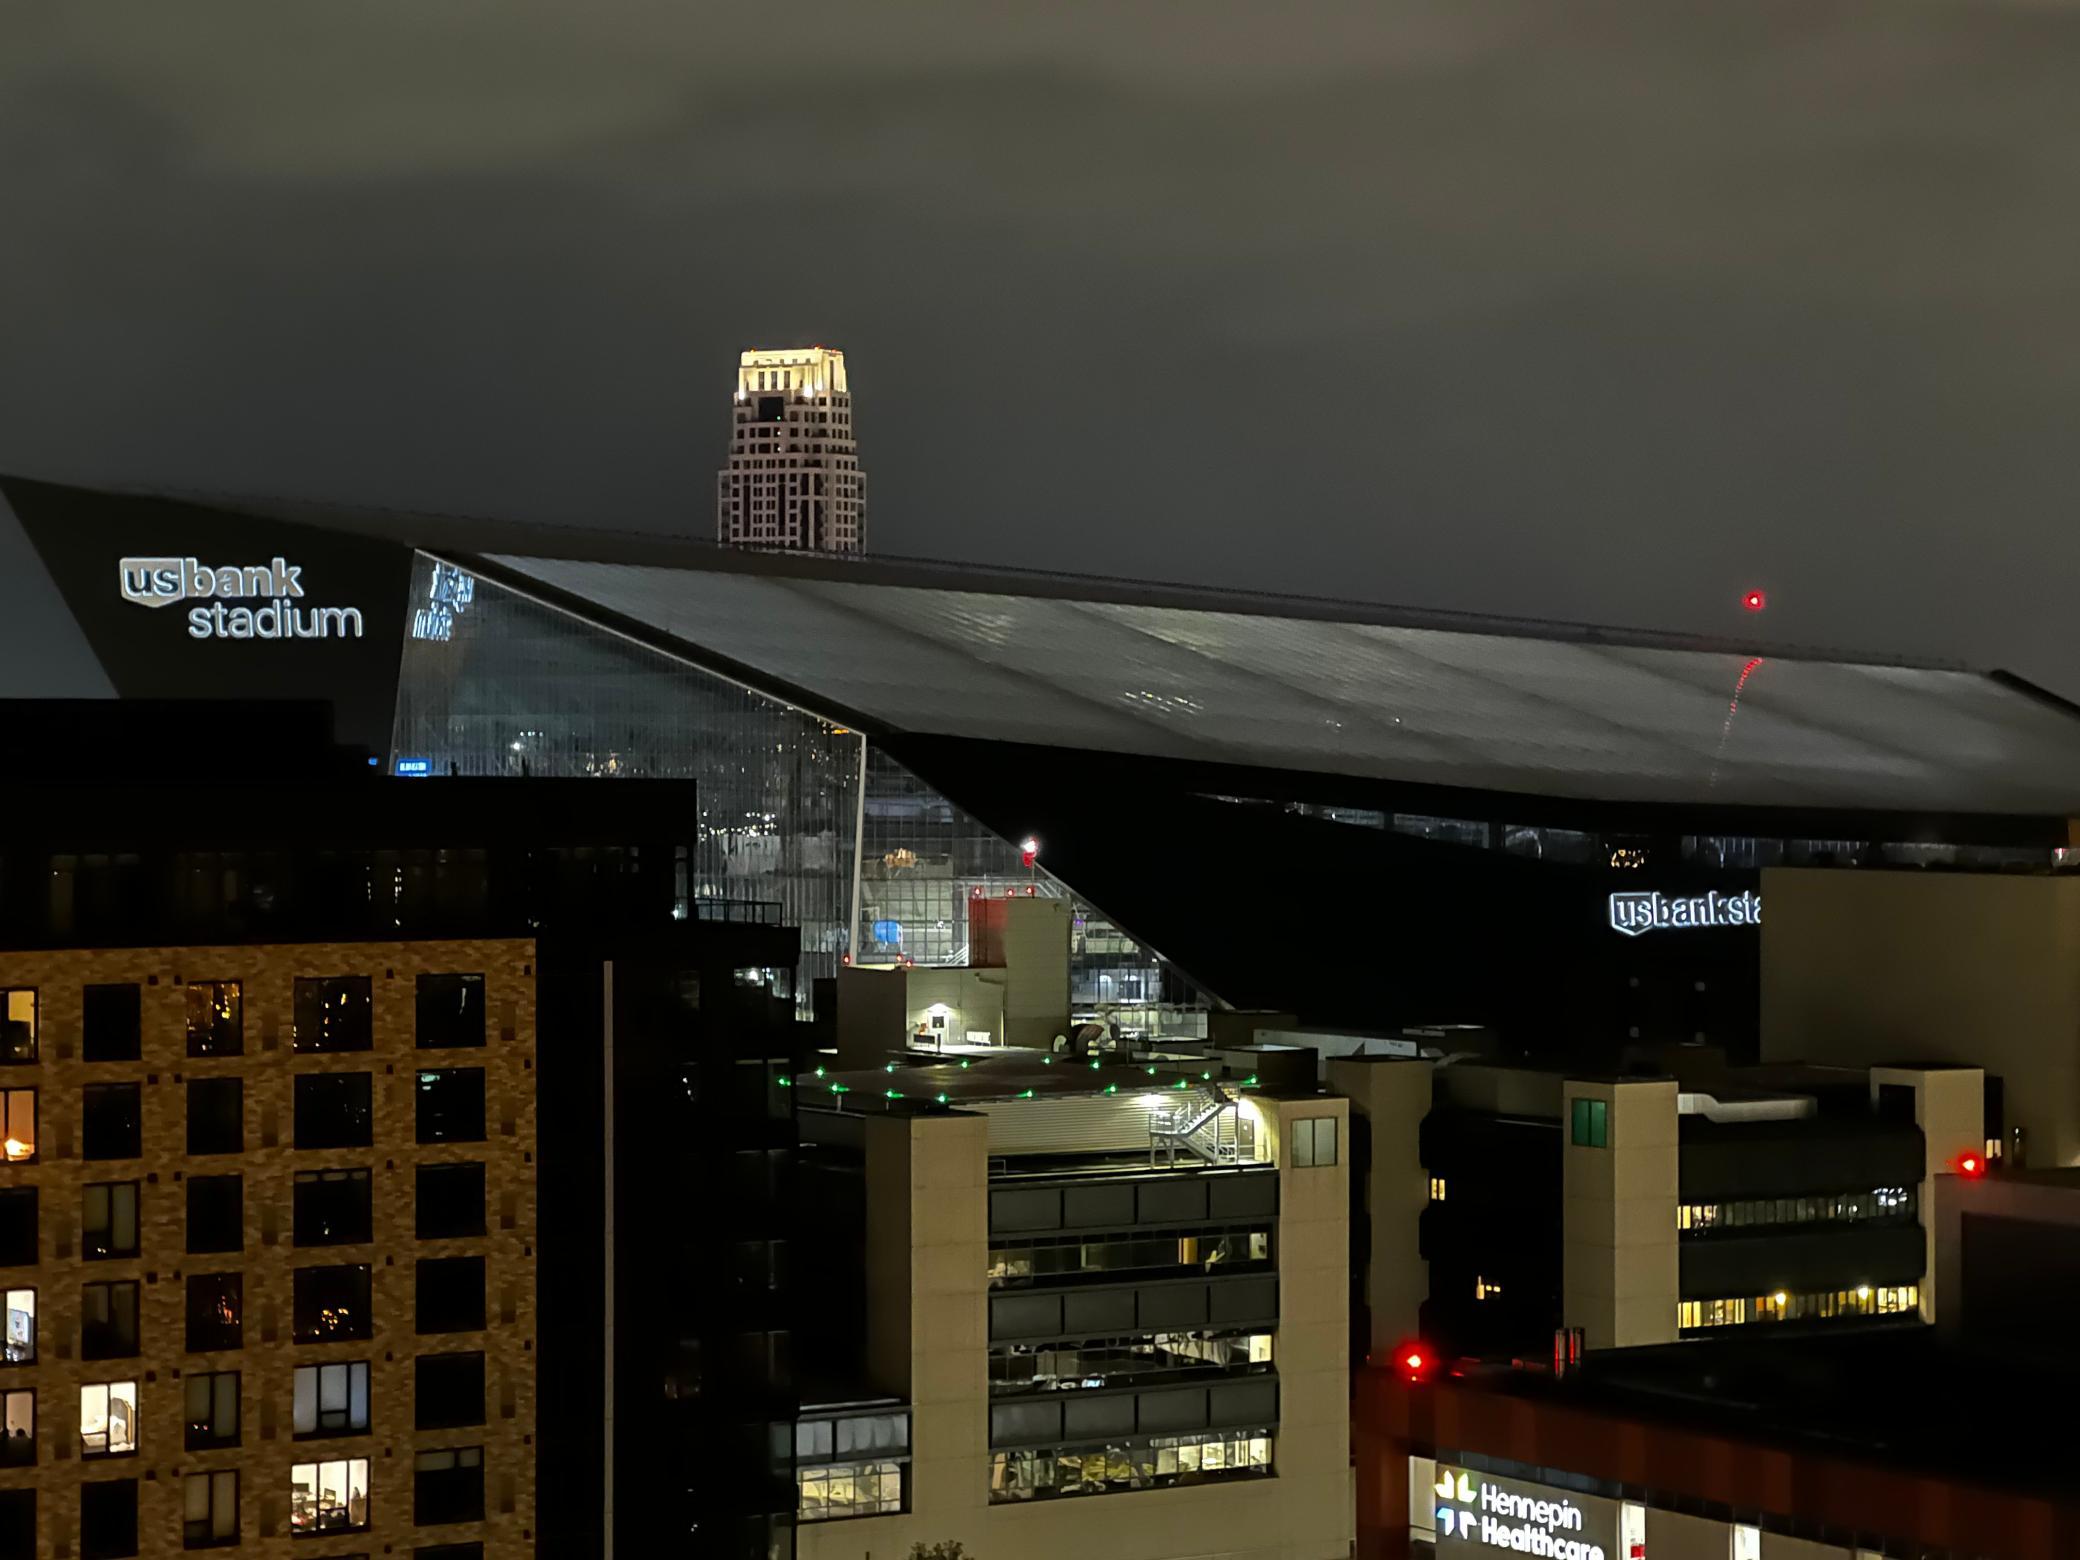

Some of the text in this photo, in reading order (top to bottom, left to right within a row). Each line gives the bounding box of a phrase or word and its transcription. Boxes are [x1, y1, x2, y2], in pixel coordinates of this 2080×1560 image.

[188, 599, 363, 638] stadium
[1481, 1482, 1582, 1533] Hennepin
[1481, 1515, 1605, 1560] Healthcare
